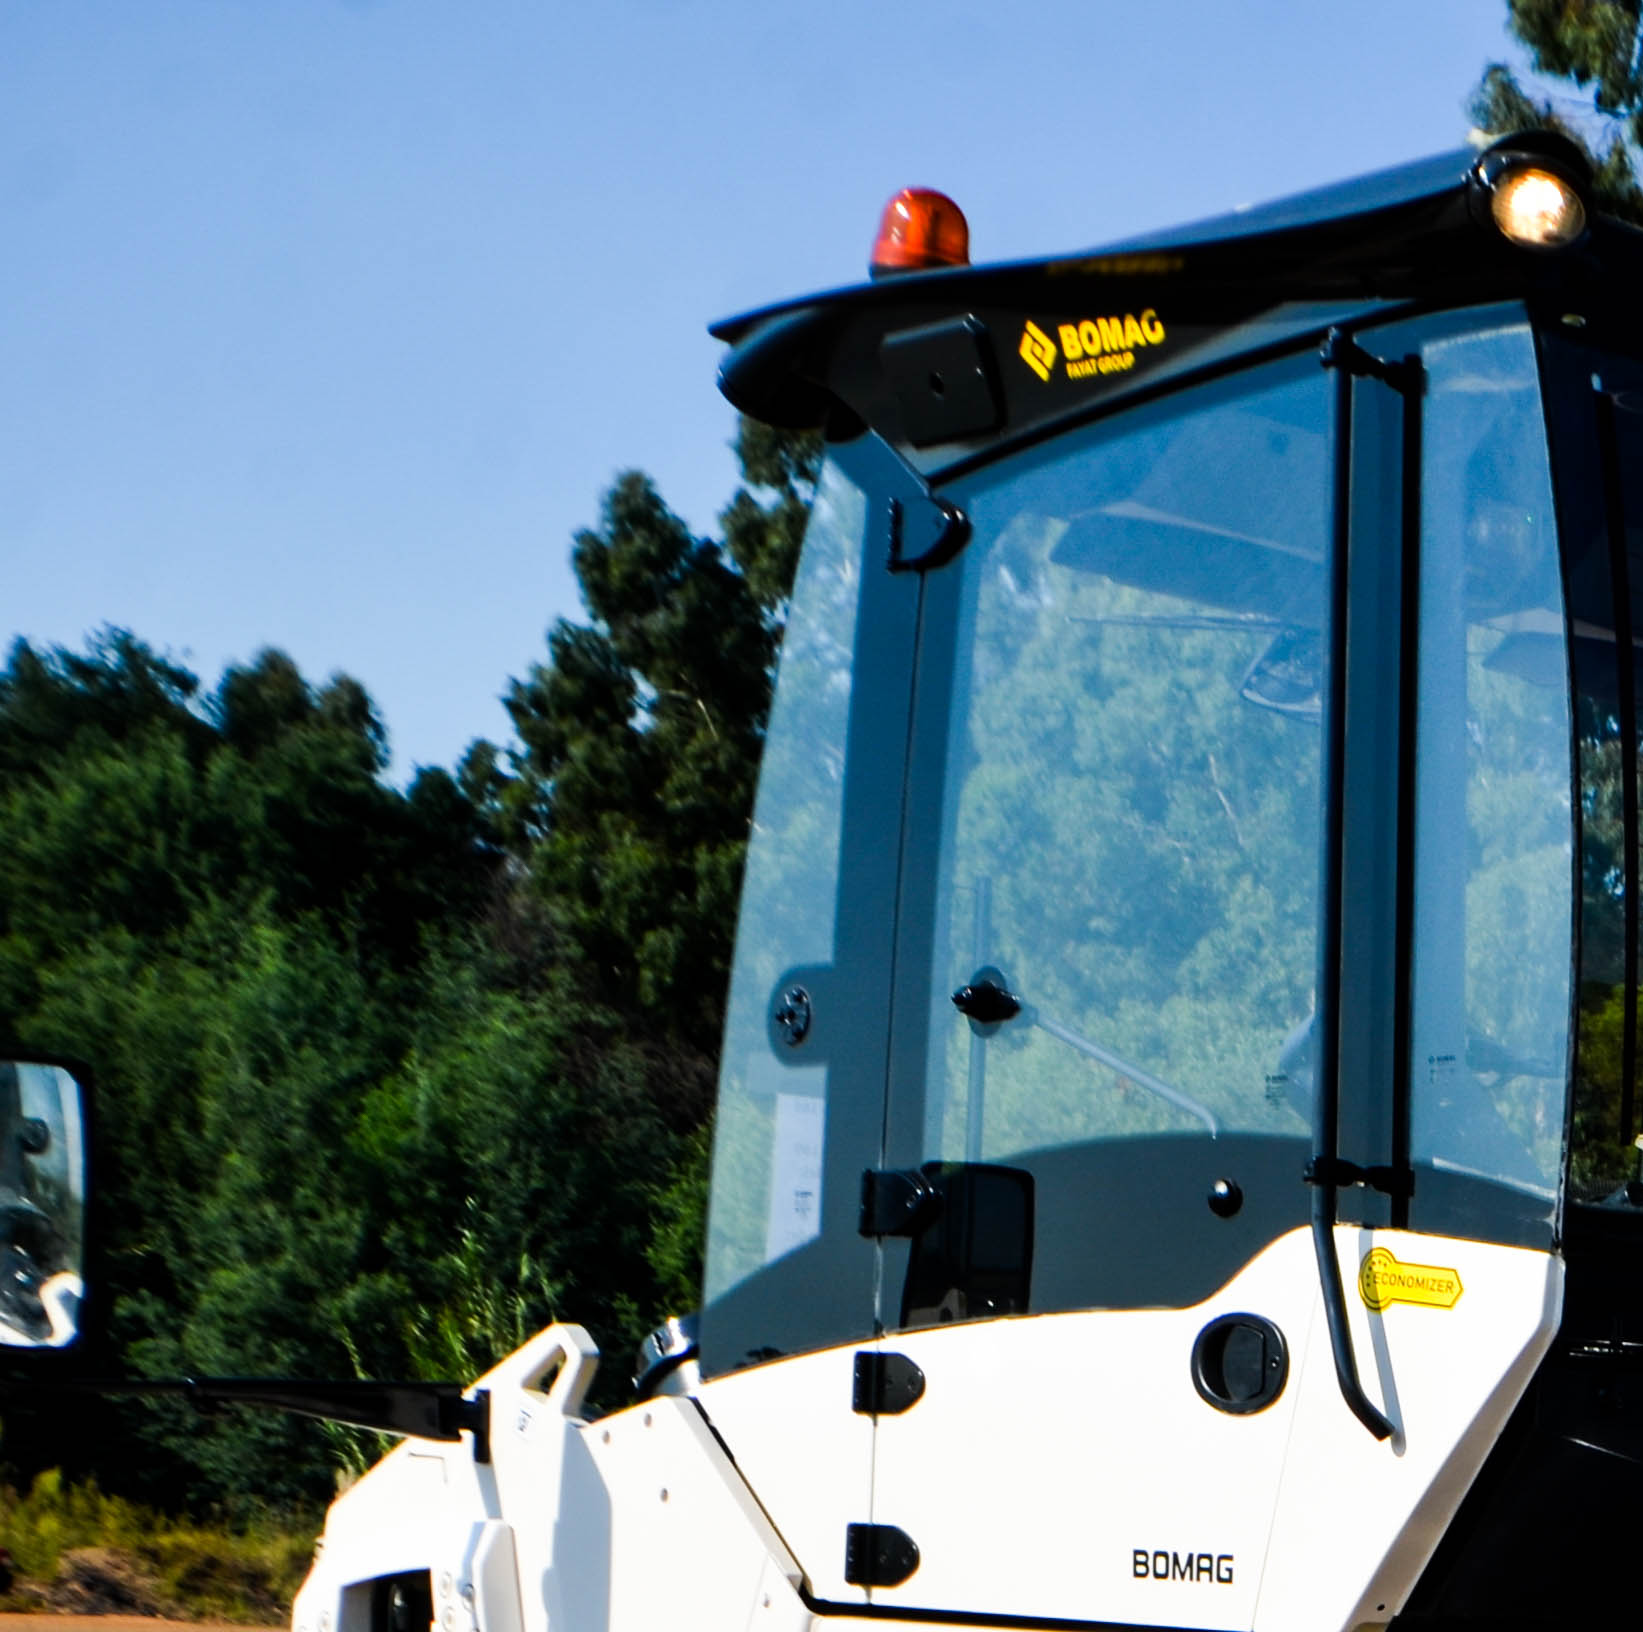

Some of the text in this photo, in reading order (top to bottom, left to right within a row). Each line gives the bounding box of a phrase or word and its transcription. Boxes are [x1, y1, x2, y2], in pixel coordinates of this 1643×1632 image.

[1058, 308, 1165, 359] BOMAG
[1098, 352, 1135, 375] GROUP
[1373, 1271, 1454, 1294] ECONOMIZER
[1132, 1549, 1233, 1584] BOMAG
